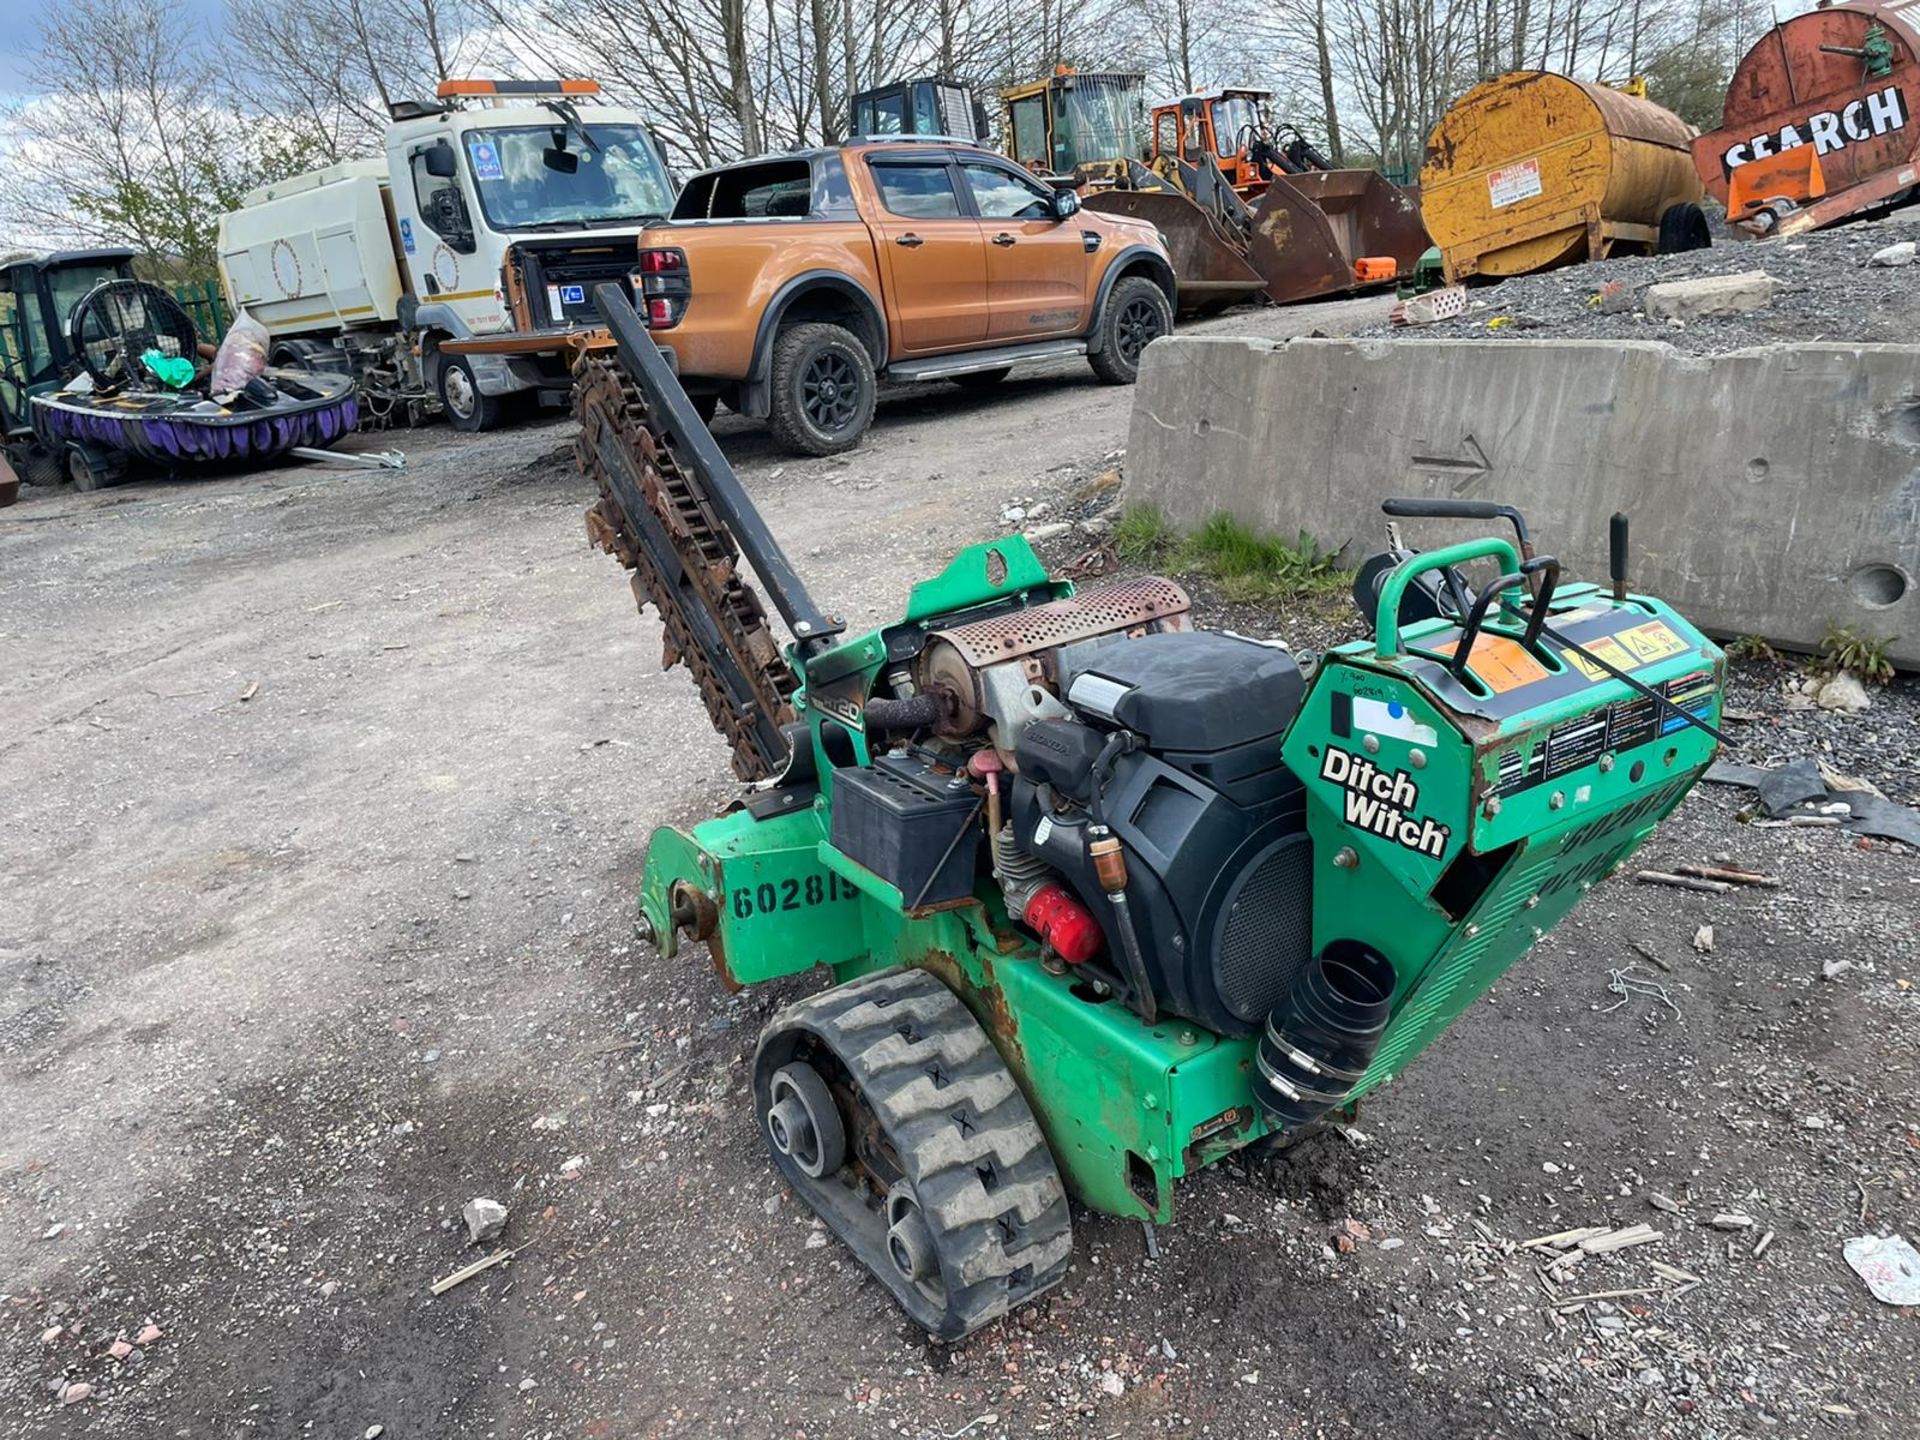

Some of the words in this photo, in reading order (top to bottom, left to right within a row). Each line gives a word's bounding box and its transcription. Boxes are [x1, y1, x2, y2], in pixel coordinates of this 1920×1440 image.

[1725, 86, 1904, 169] SEARCH
[1322, 747, 1417, 809] Ditch
[1345, 789, 1446, 857] Witch
